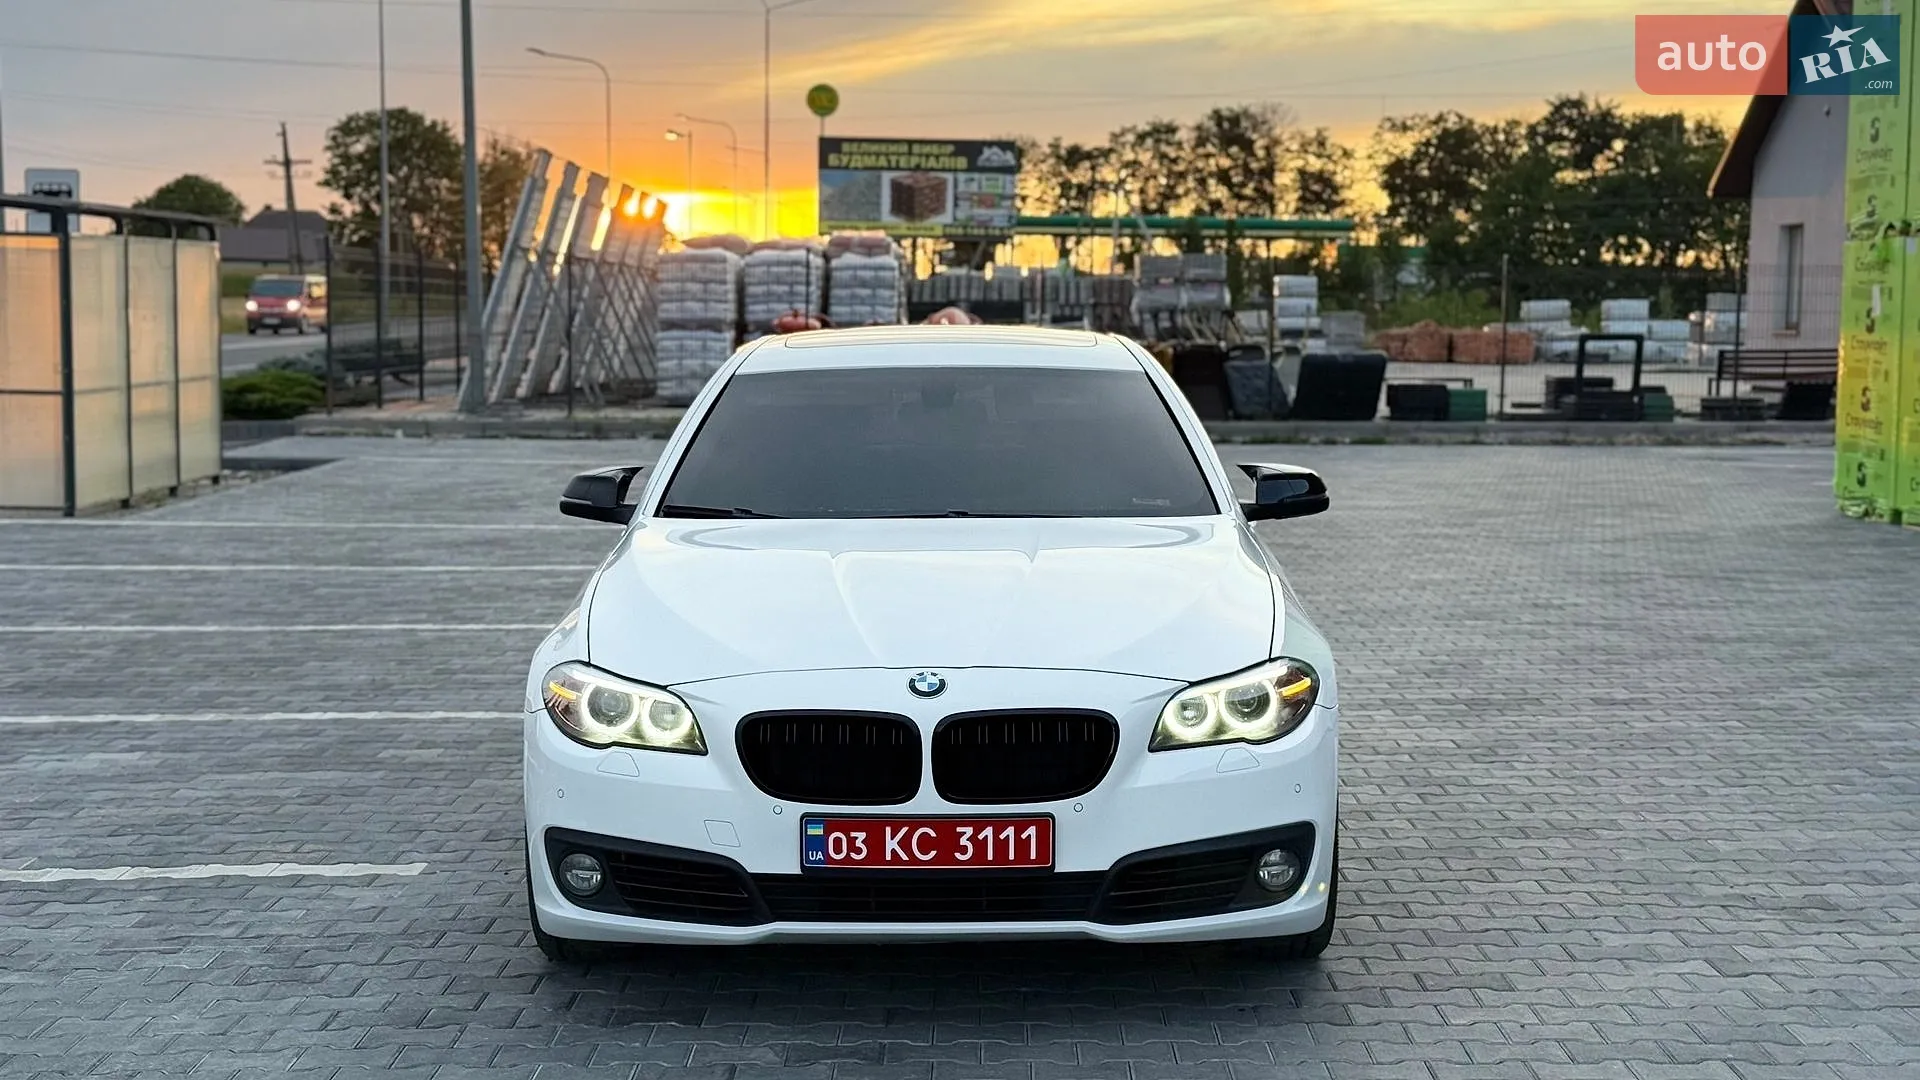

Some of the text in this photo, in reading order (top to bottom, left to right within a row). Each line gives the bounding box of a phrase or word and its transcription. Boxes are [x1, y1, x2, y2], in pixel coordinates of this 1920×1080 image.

[828, 153, 968, 170] БУДМАТЕРІАЛІВ
[828, 825, 1038, 862] 03 KC 3111
[808, 851, 824, 861] UA
